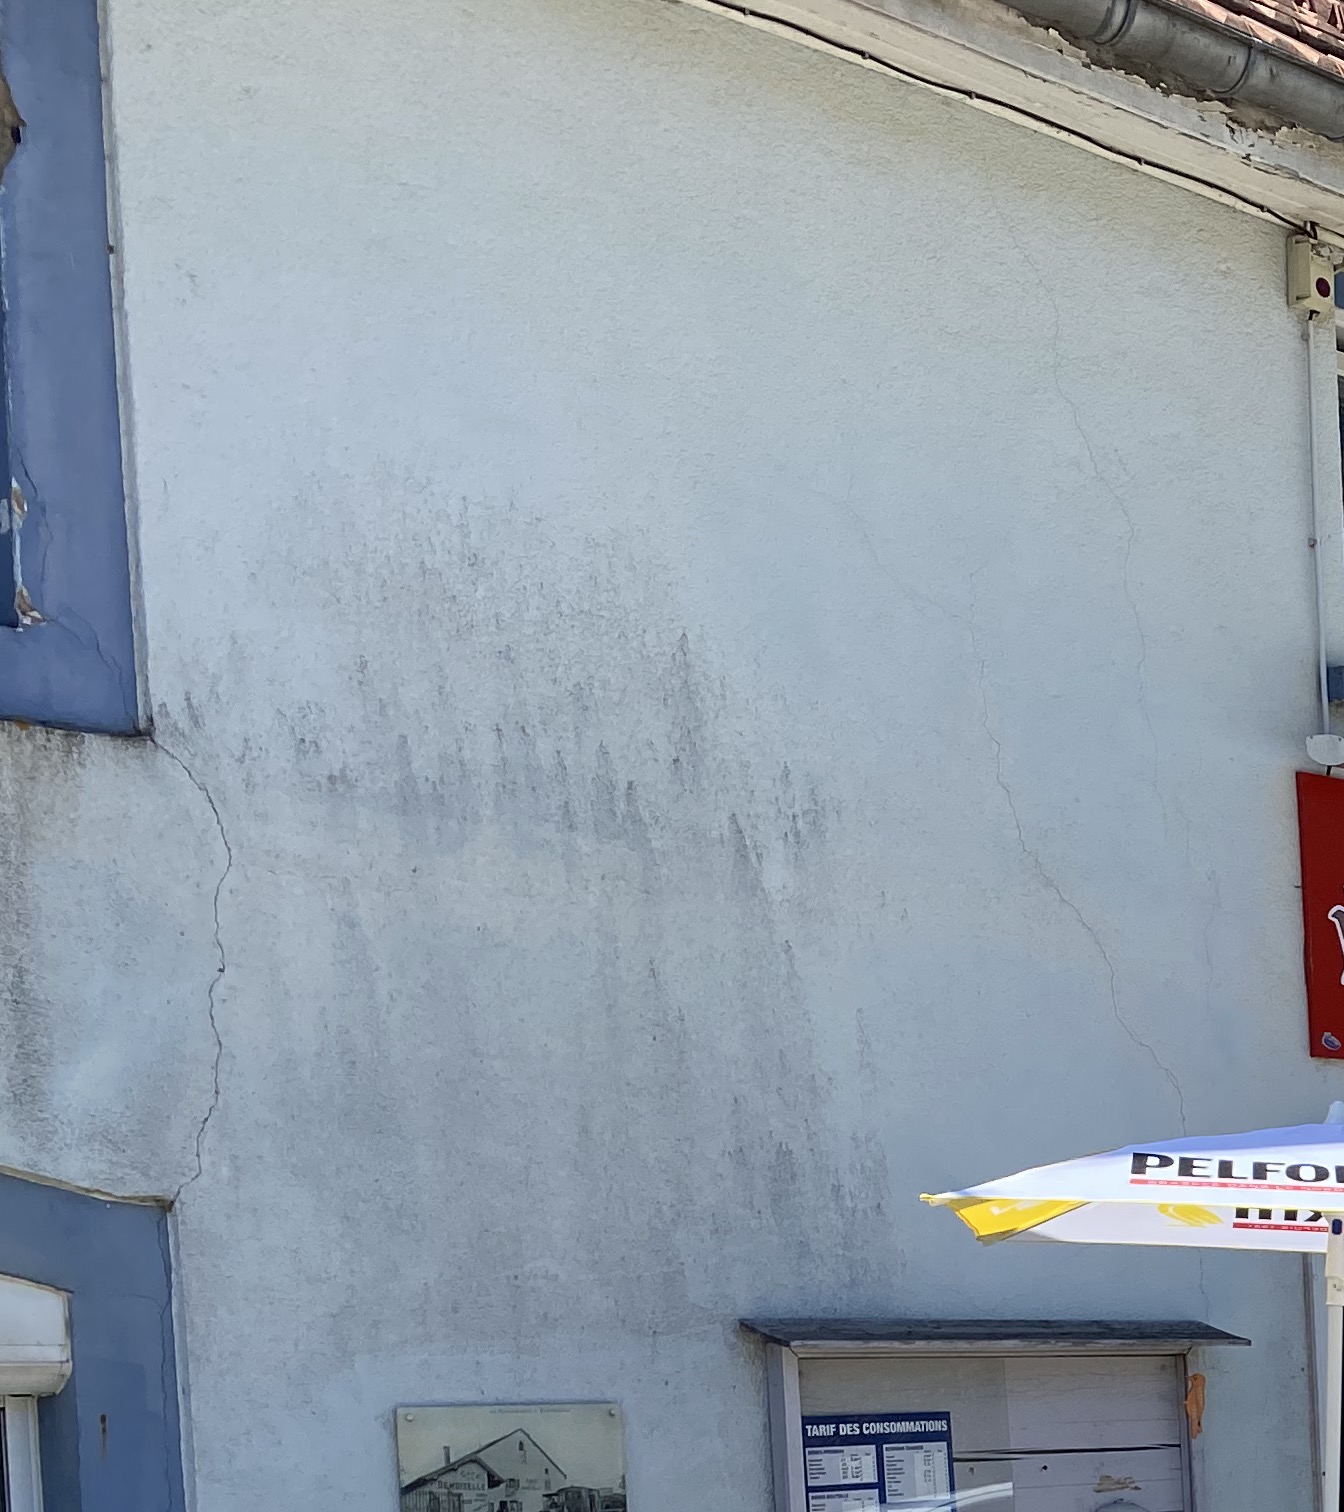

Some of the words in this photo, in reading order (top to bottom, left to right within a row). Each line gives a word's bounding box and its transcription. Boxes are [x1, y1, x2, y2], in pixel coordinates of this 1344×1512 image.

[805, 1423, 836, 1437] TARIF
[839, 1422, 860, 1435] DES
[863, 1419, 948, 1434] CONSOMMATIONS
